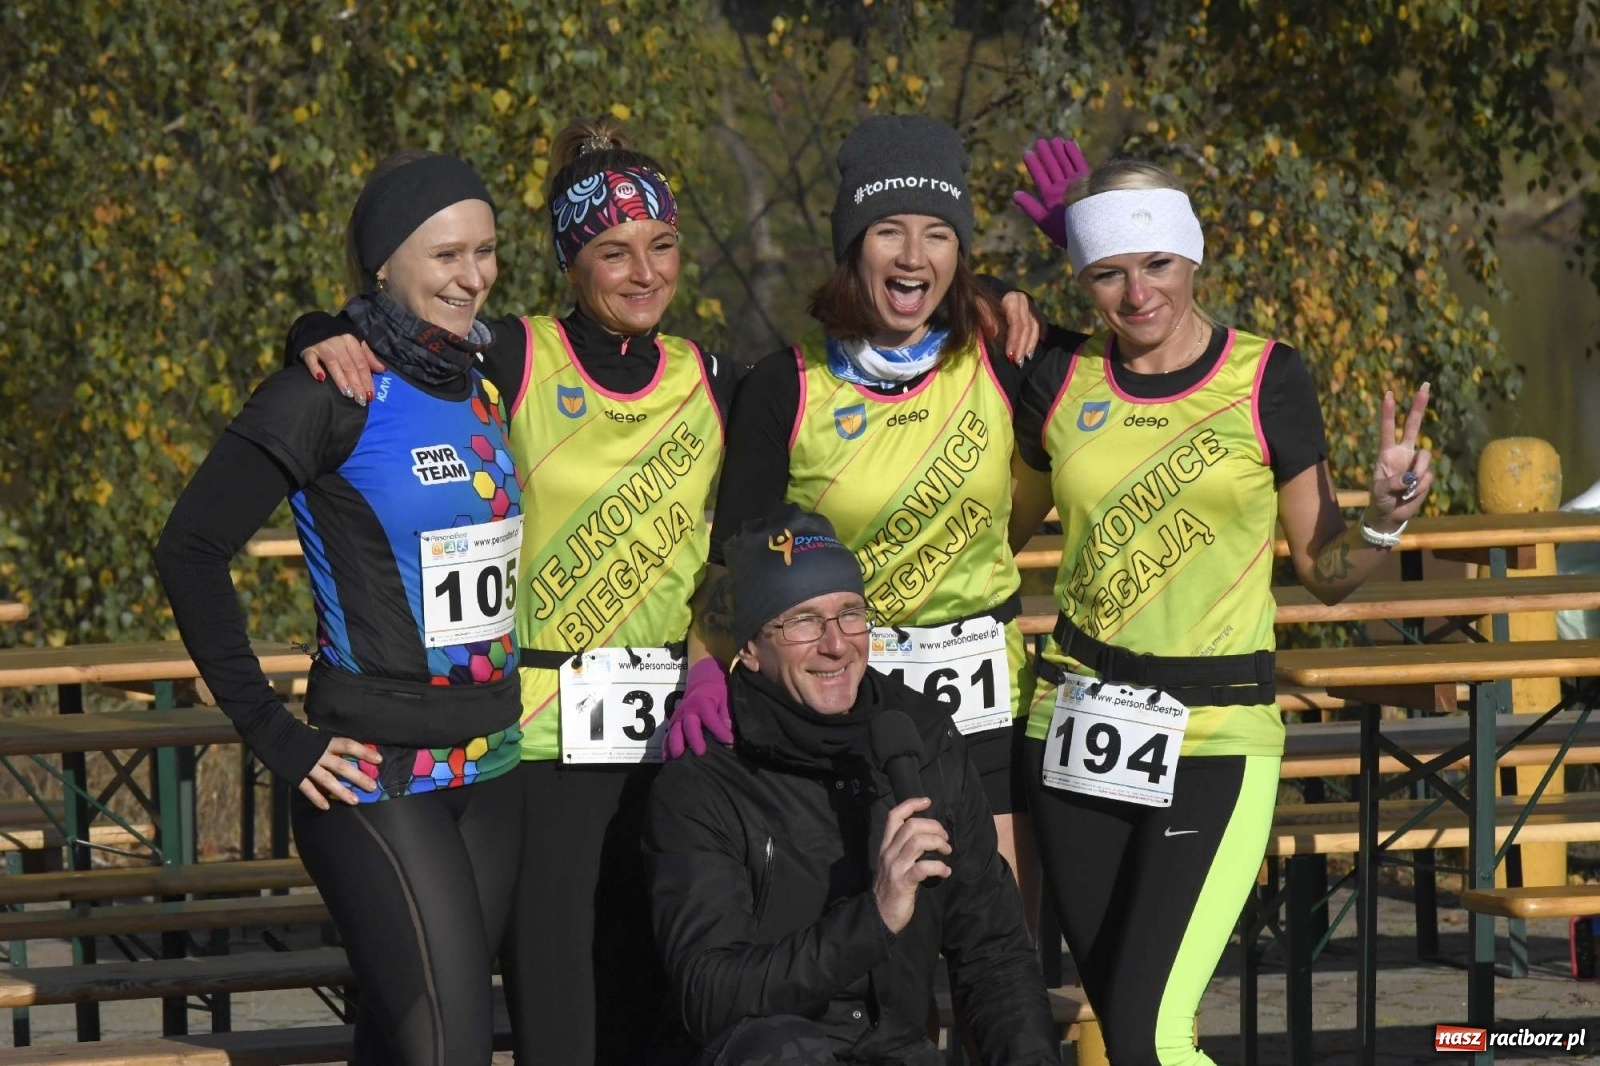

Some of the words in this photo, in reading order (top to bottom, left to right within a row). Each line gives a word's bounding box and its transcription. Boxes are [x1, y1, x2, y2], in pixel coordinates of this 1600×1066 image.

[854, 176, 962, 204] #tomorrow
[604, 410, 647, 423] deep
[886, 409, 929, 427] deep
[1124, 415, 1169, 429] deep
[415, 448, 457, 465] PWR
[417, 463, 468, 481] TEAM
[855, 410, 989, 583] JKOWICE
[530, 421, 705, 620] JEJKOWICE
[875, 497, 993, 626] EGAJĄ
[435, 557, 516, 622] 105
[920, 628, 999, 649] www.personalbest.pl
[1091, 694, 1183, 717] www.personalbest.pl
[1055, 716, 1169, 784] 194
